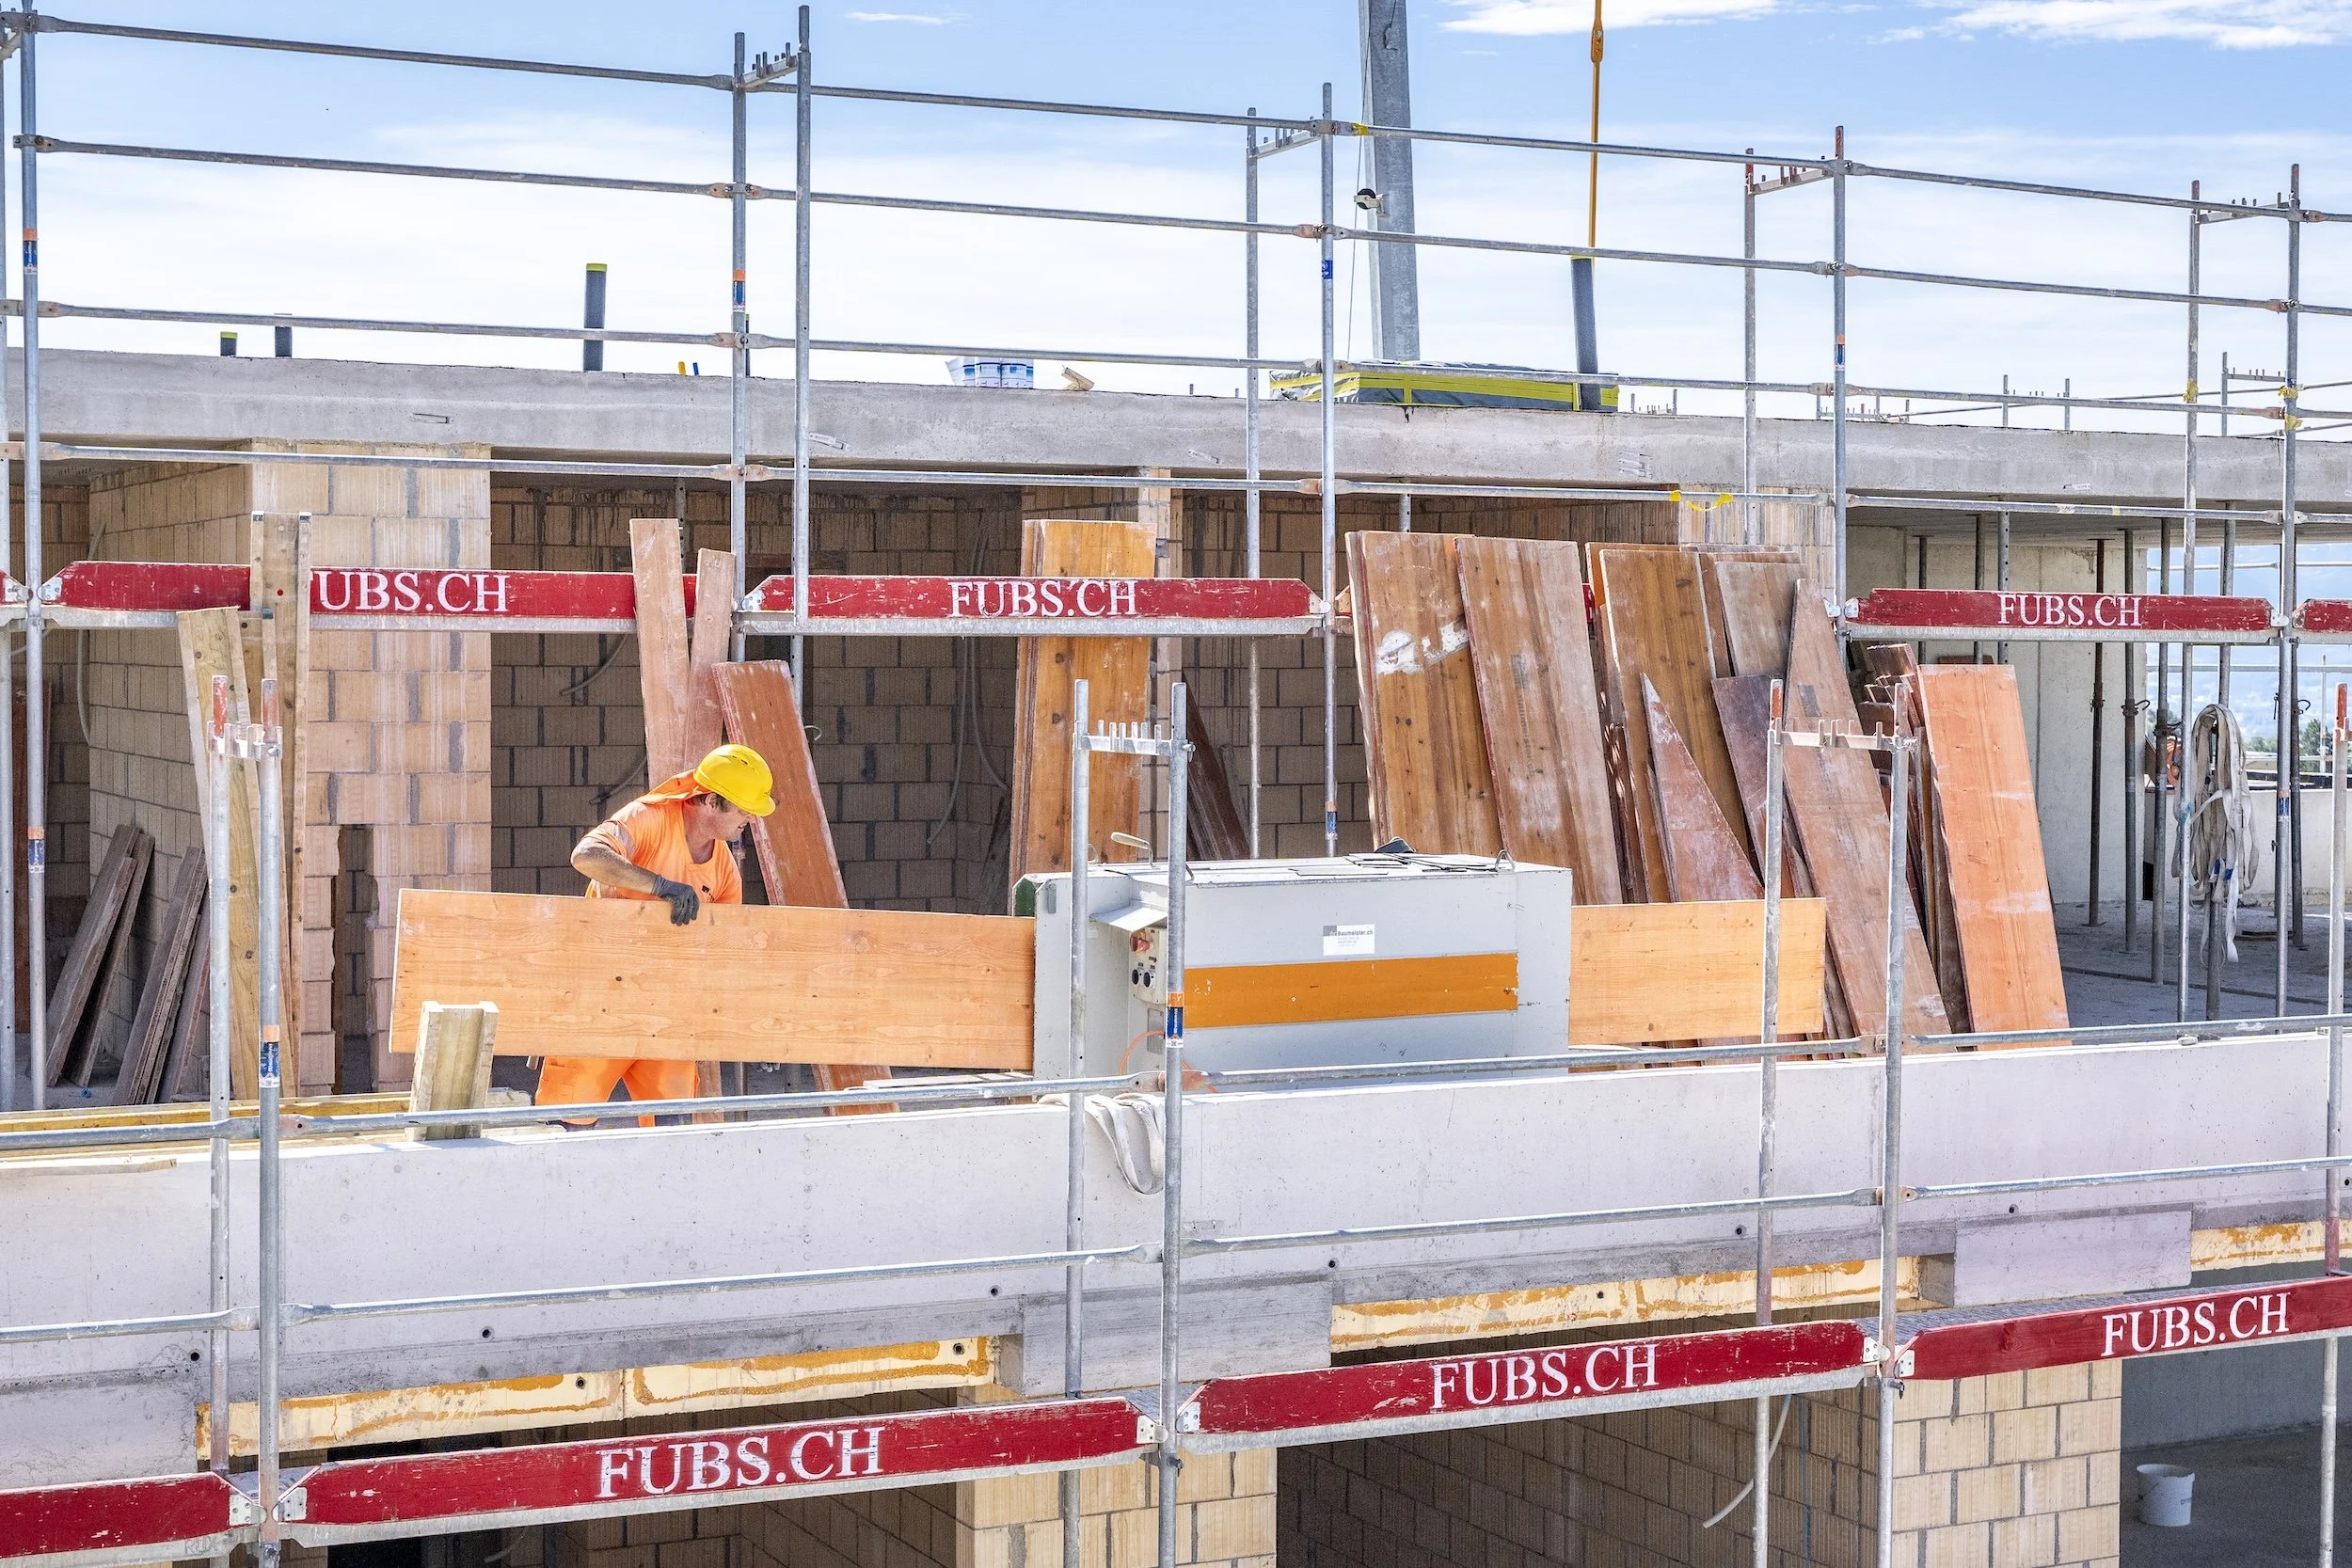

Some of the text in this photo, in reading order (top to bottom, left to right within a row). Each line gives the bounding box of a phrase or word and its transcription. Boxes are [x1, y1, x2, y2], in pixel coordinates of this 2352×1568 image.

[310, 571, 511, 612] UBS.CH
[947, 579, 1137, 618] FUBS.CH
[1998, 594, 2142, 626] FUBS.CH
[2100, 1292, 2291, 1357] FUBS.CH
[1428, 1343, 1660, 1409] FUBS.CH
[595, 1426, 886, 1498] FUBS.CH
